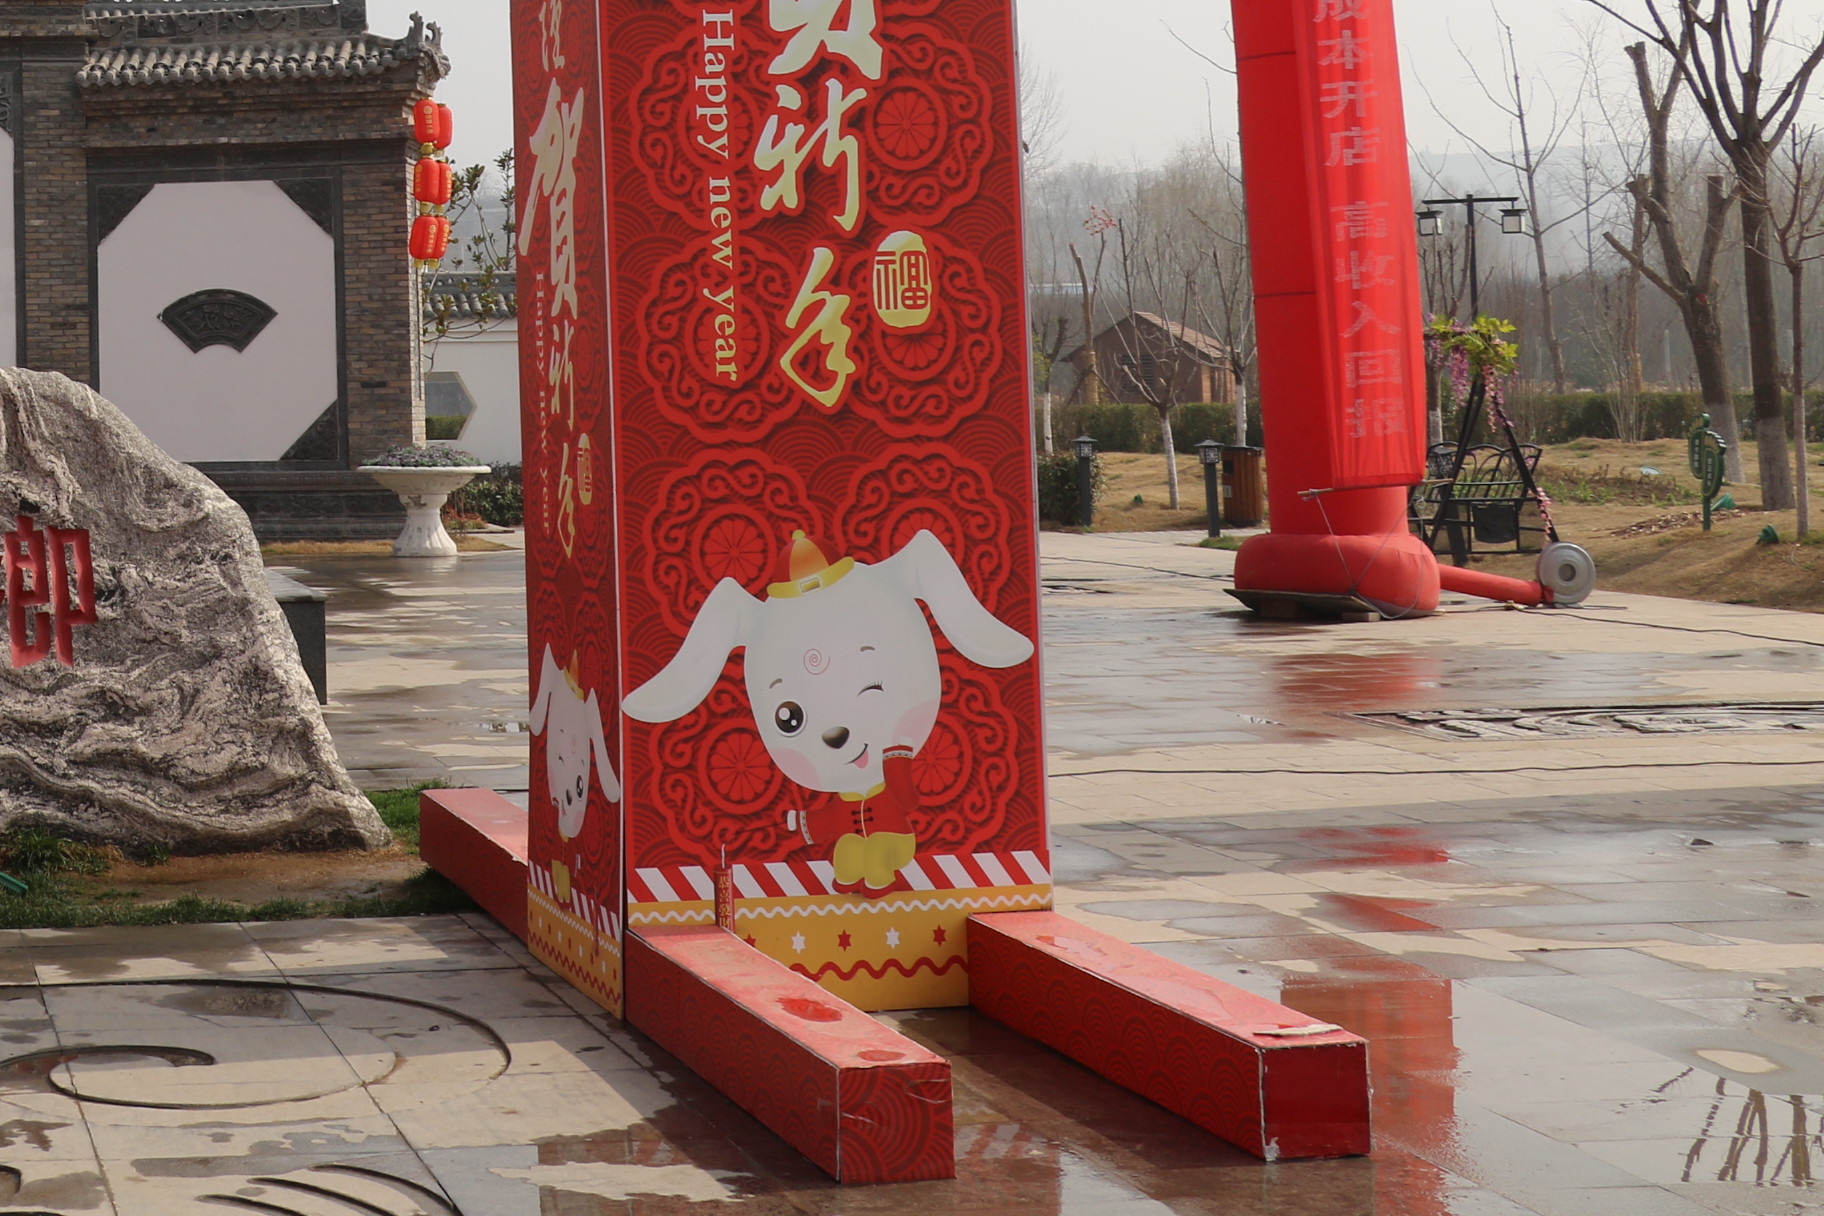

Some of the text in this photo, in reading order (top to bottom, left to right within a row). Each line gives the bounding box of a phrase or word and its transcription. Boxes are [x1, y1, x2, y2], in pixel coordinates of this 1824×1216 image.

[694, 8, 737, 382] Happy new year
[1329, 200, 1408, 438] 高收入回报
[536, 271, 550, 535] Happy new year
